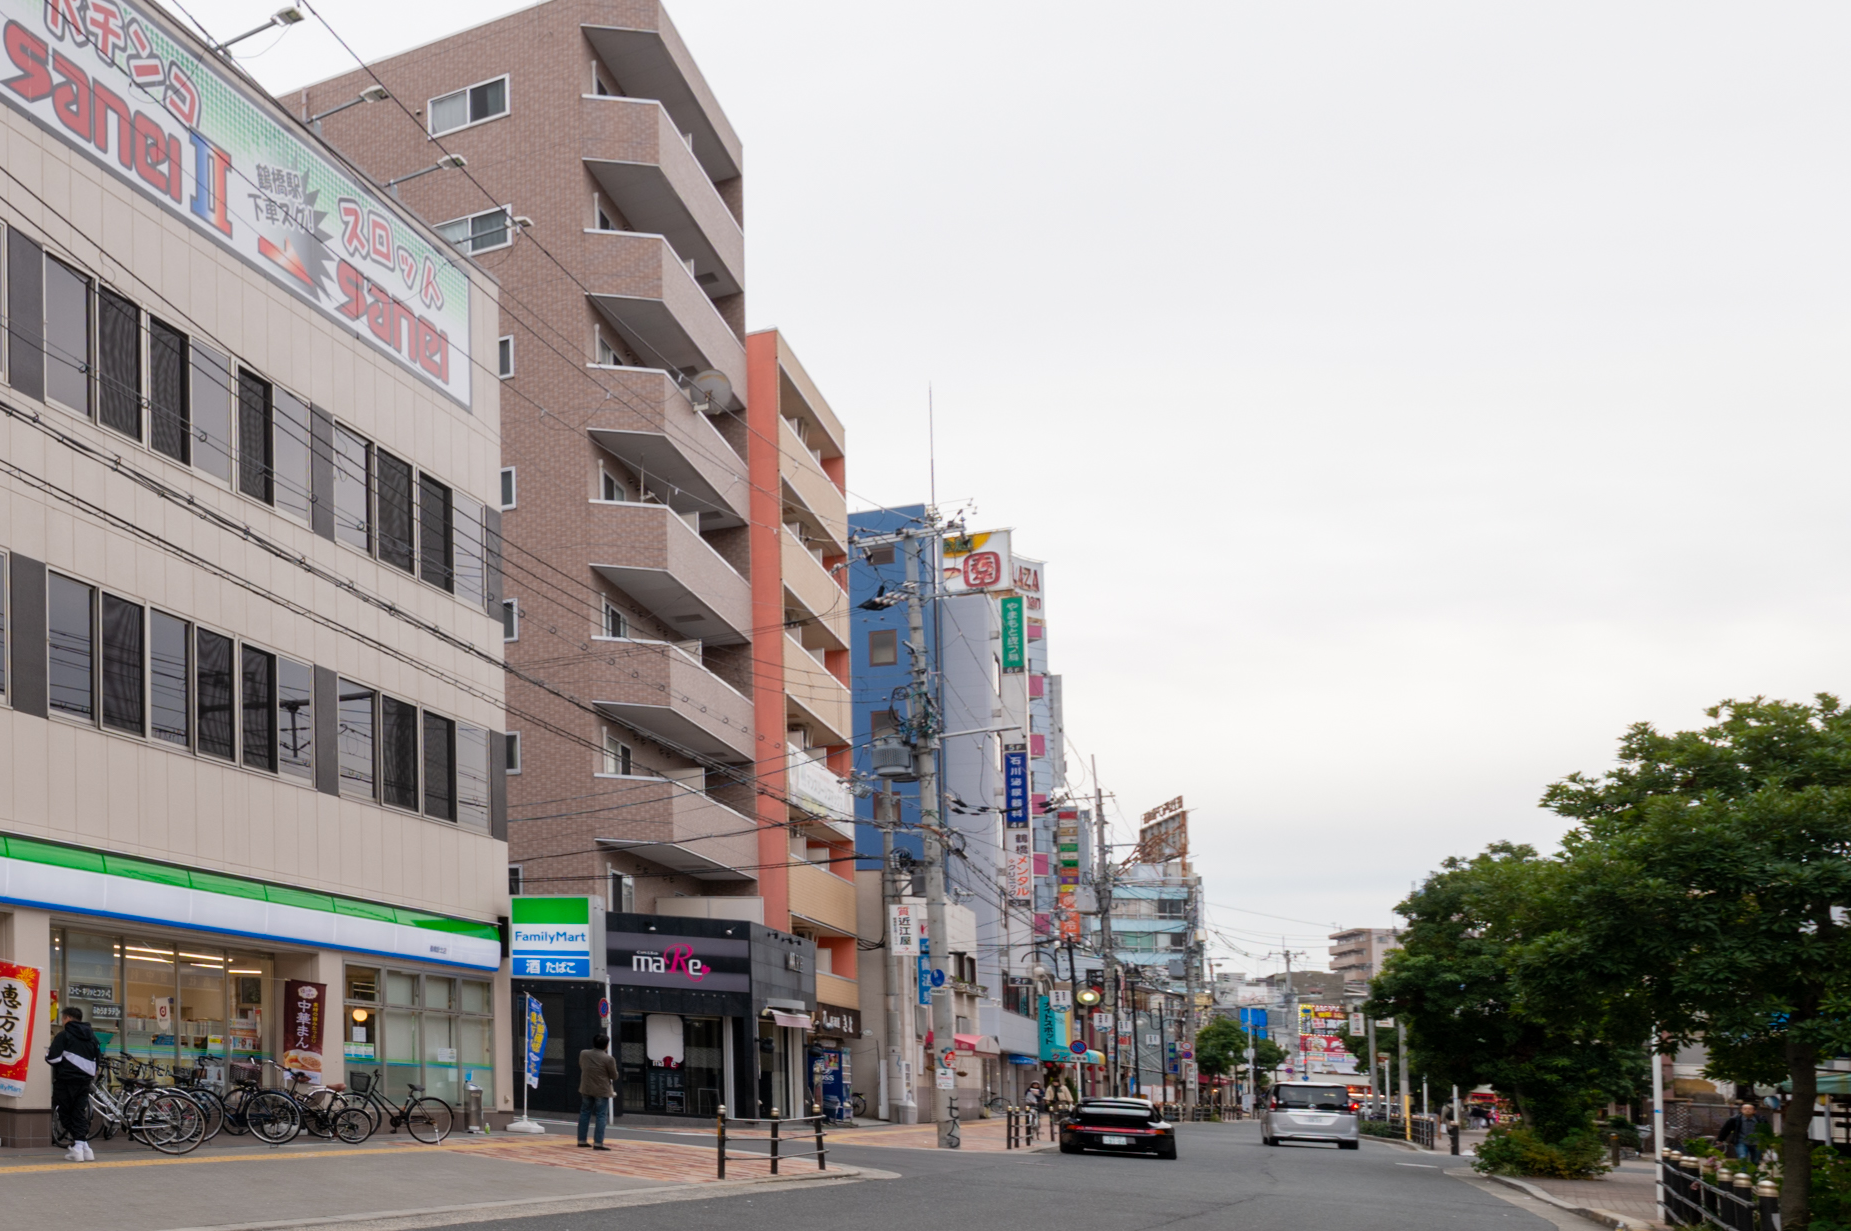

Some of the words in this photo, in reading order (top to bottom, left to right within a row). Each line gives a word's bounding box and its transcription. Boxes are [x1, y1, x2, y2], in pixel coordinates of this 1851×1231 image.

[255, 162, 303, 200] 鶴橋駅
[335, 195, 445, 310] スロット
[1010, 756, 1023, 818] 石川泌尿器科
[514, 930, 587, 945] FamilyMart
[898, 917, 912, 945] 近江屋
[526, 959, 541, 974] 酒
[545, 961, 576, 974] たばこ
[1015, 977, 1028, 985] 2F
[295, 1000, 312, 1049] 中華まん
